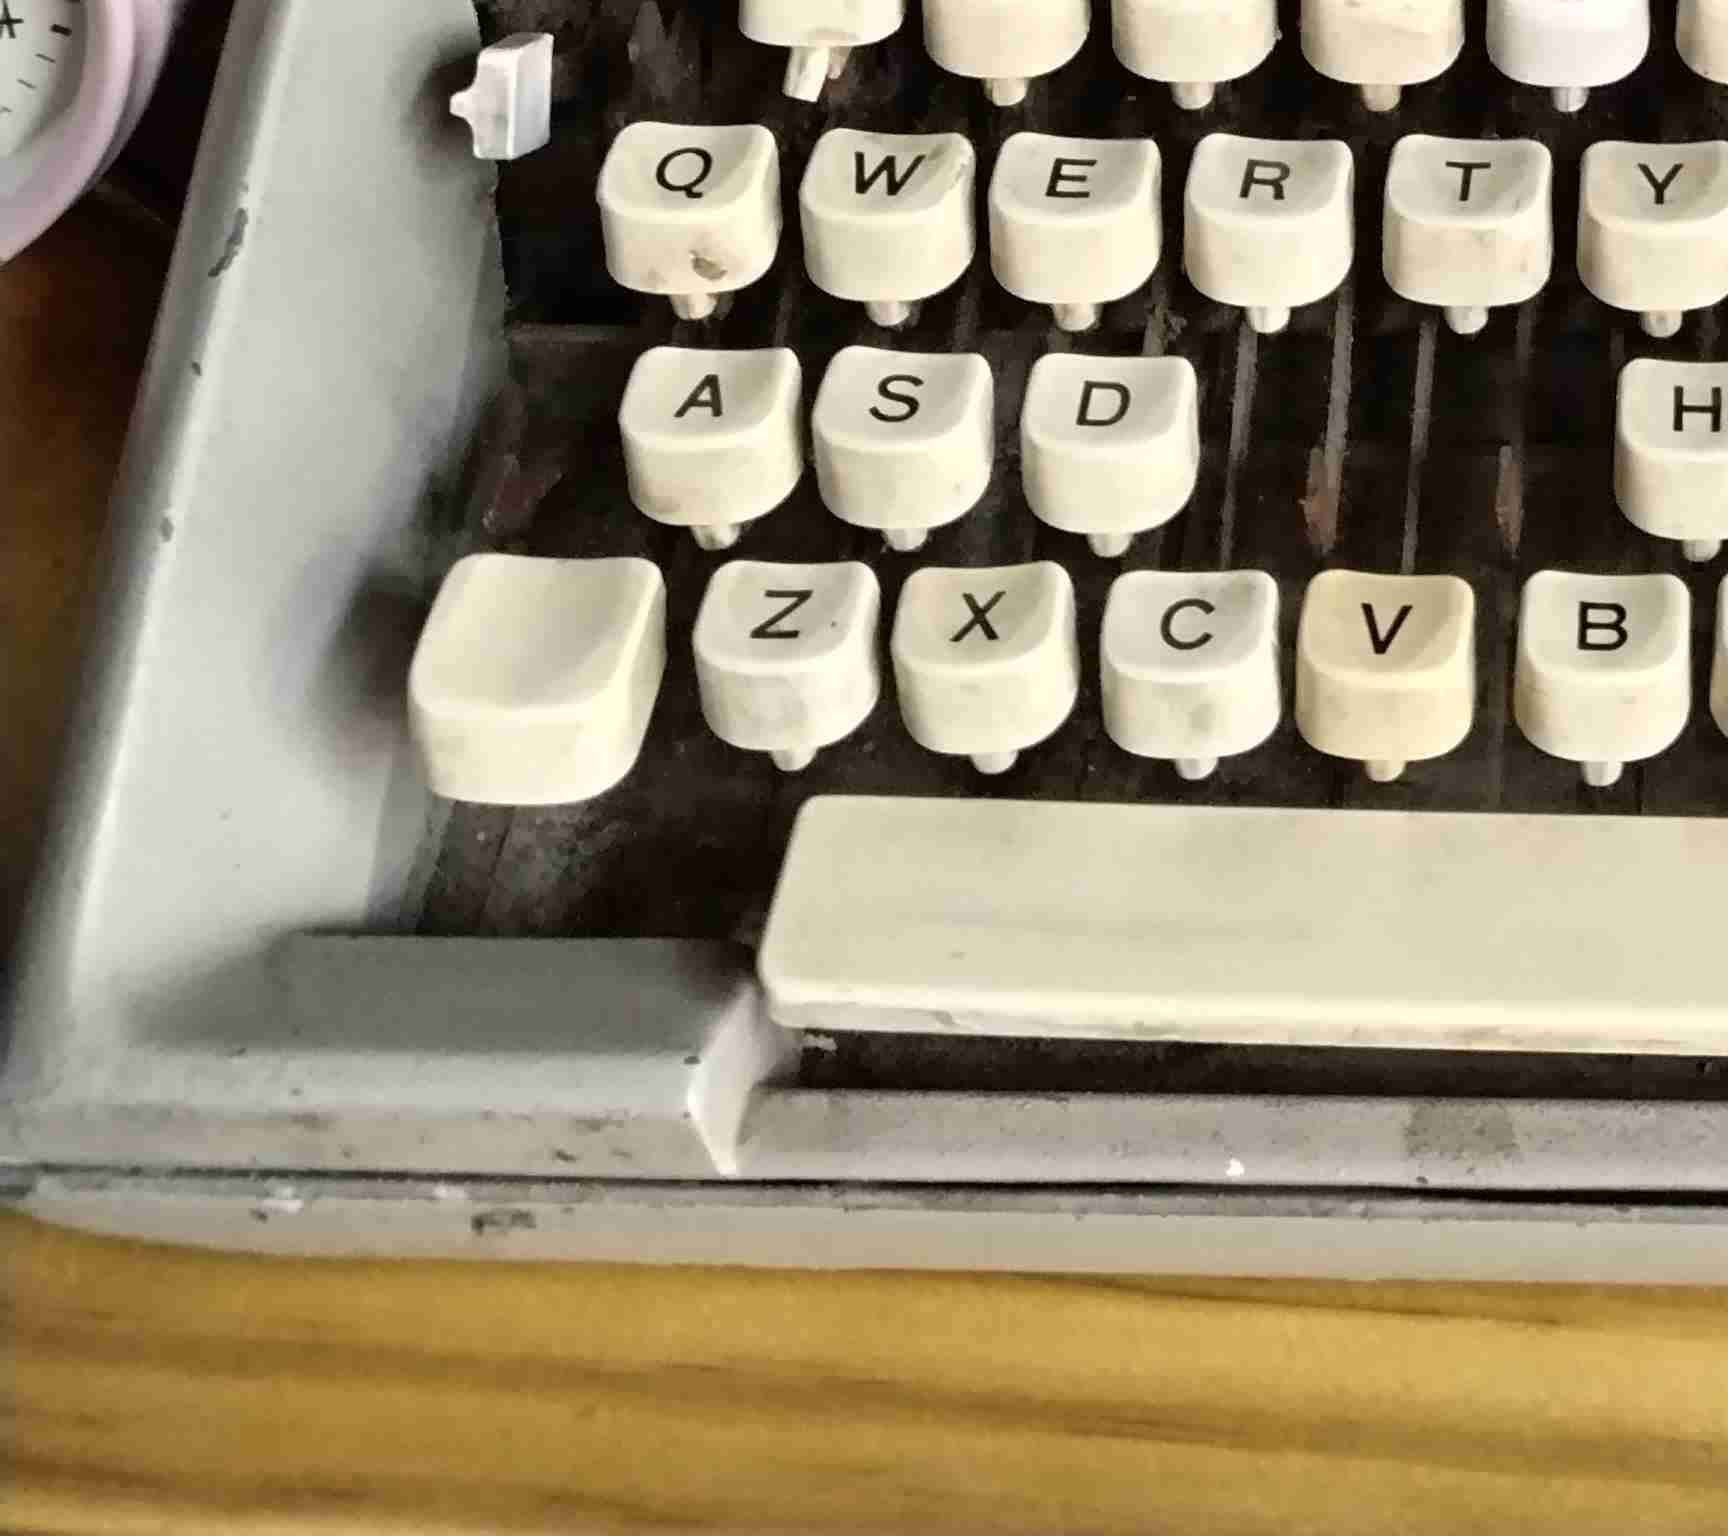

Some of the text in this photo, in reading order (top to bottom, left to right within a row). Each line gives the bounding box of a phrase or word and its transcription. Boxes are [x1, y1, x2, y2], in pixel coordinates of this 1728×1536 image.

[655, 147, 713, 199] Q
[854, 151, 927, 197] W
[1045, 157, 1098, 199] E
[1239, 159, 1291, 201] R
[1445, 161, 1492, 202] T
[1637, 163, 1684, 206] Y
[673, 374, 724, 418] A
[869, 374, 924, 423] S
[1076, 380, 1131, 427] D
[1673, 385, 1723, 433] H
[750, 589, 814, 640] Z
[949, 590, 1007, 643] X
[1160, 598, 1216, 651] C
[1361, 602, 1414, 655] V
[1577, 601, 1628, 652] B
